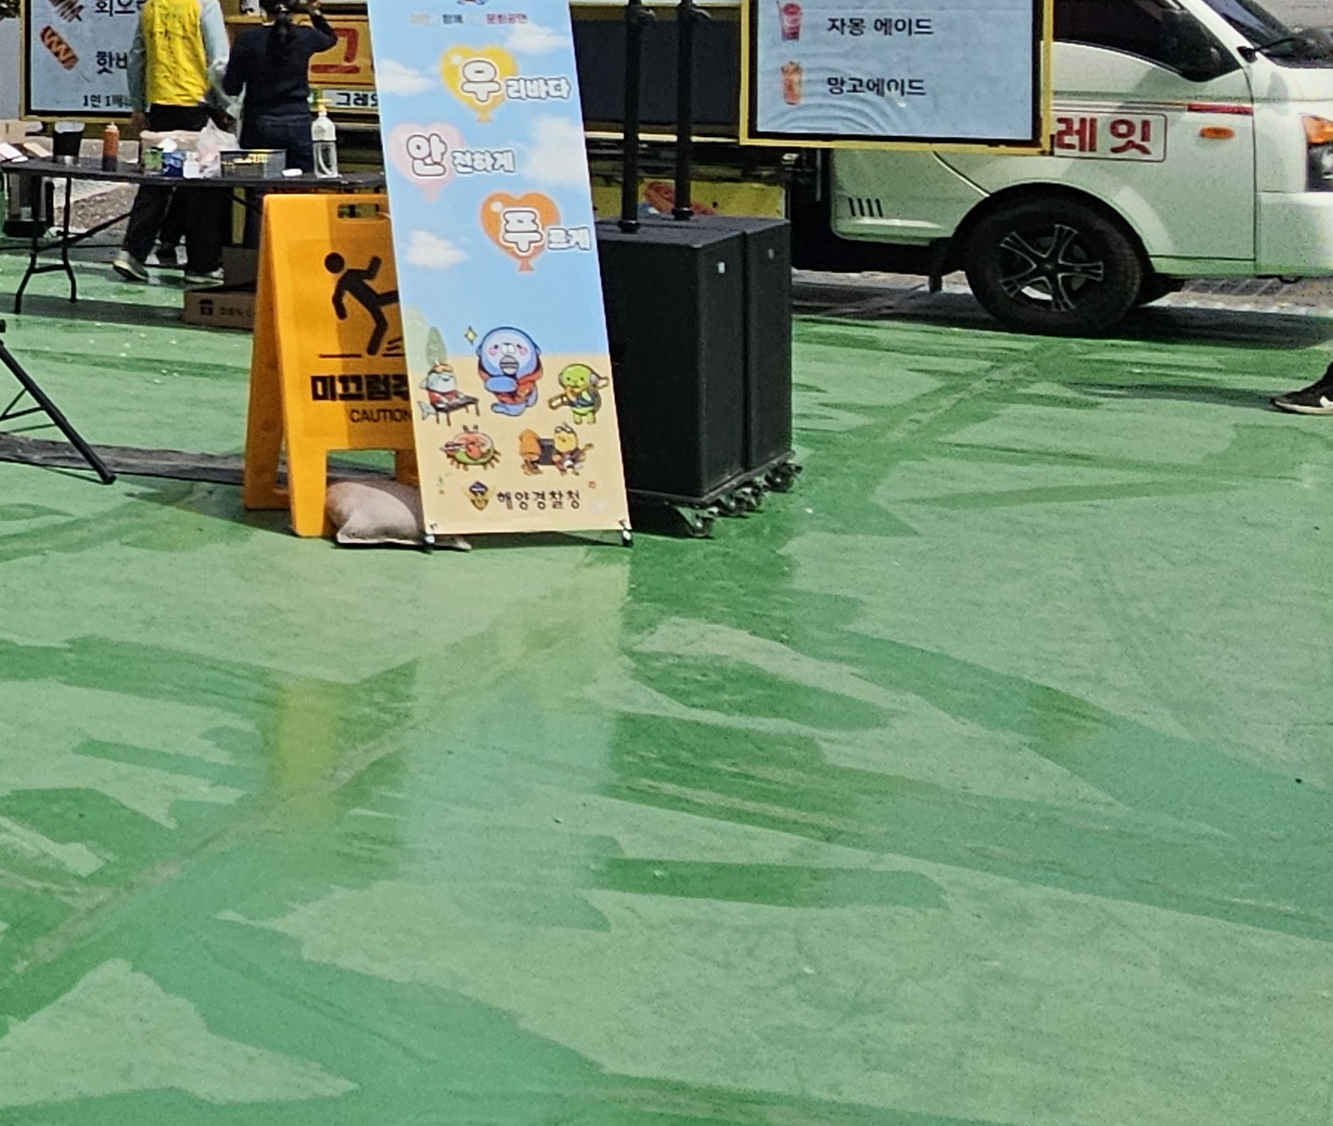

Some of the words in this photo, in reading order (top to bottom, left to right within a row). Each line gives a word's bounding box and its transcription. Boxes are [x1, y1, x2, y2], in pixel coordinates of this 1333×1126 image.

[827, 17, 867, 36] 자몽
[874, 17, 934, 36] 에이드
[827, 76, 927, 97] 망고에이드
[496, 488, 582, 512] 해양경찰청
